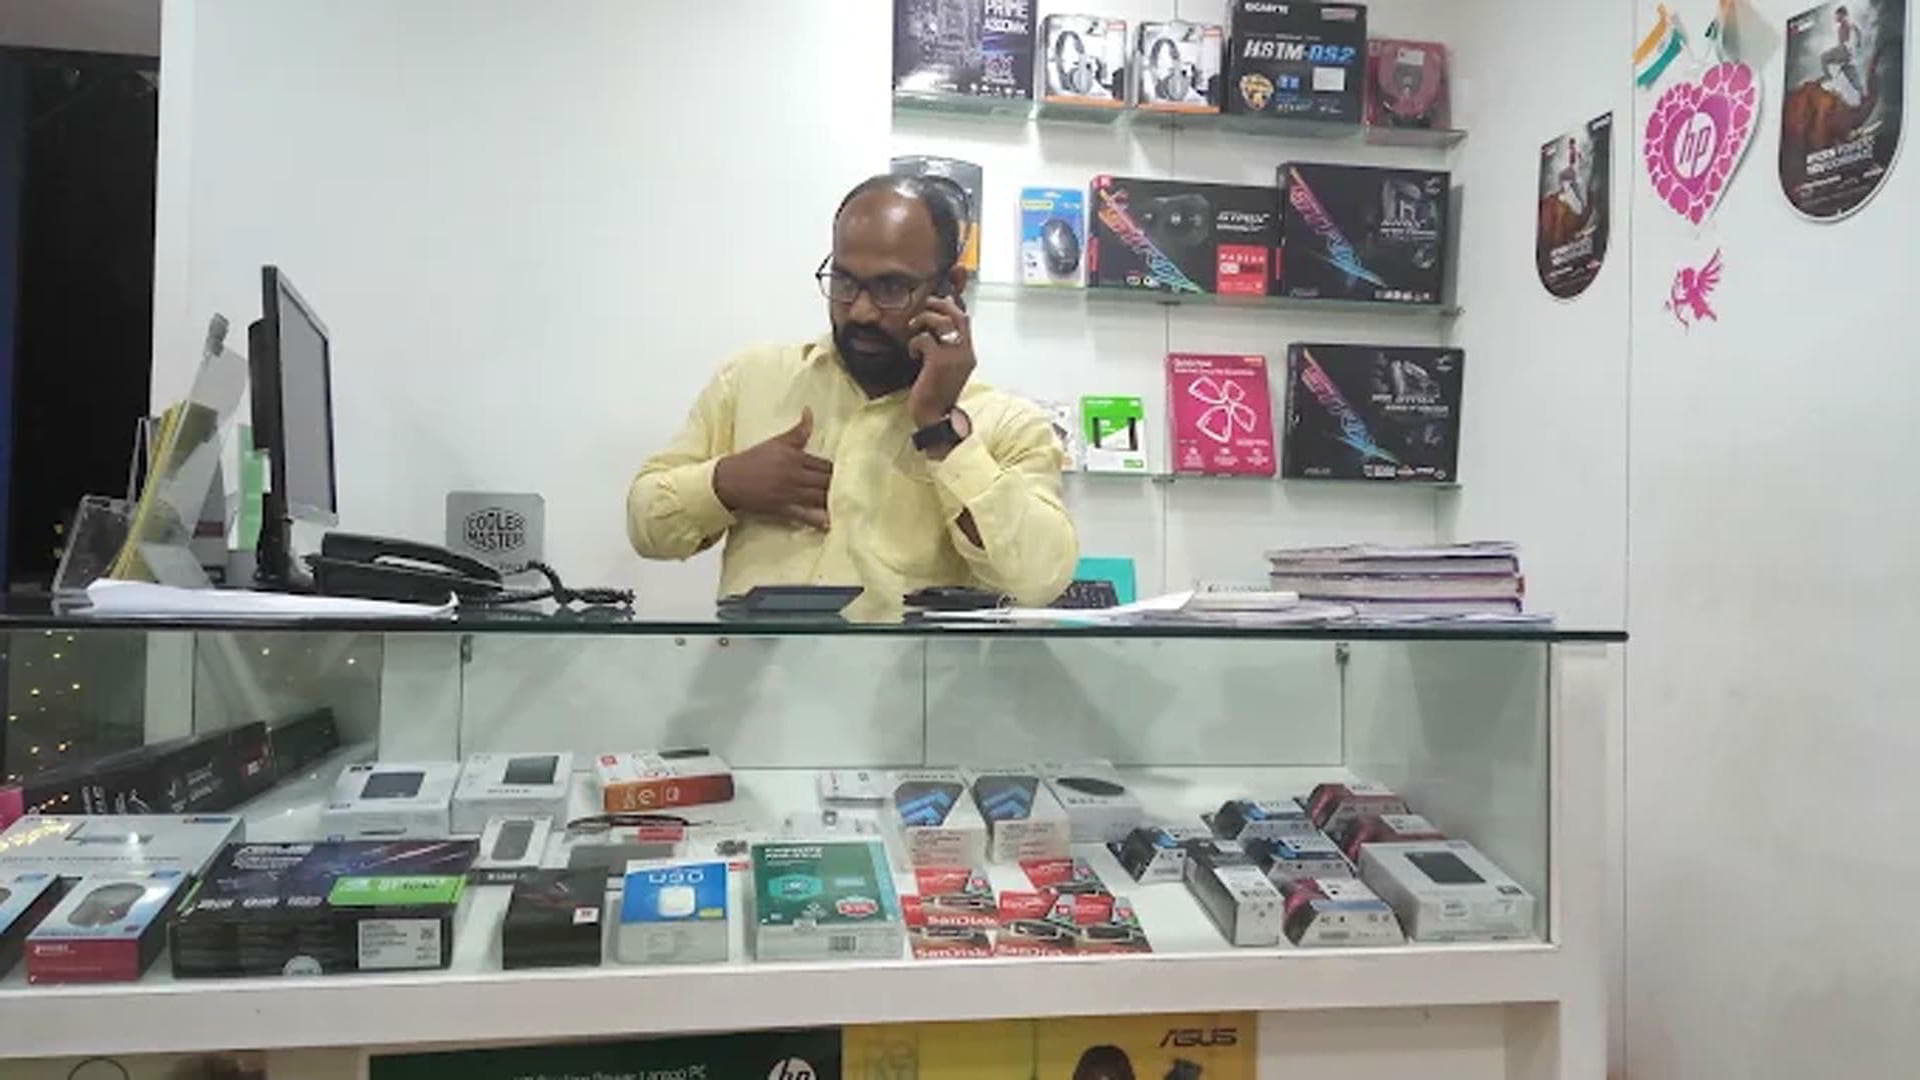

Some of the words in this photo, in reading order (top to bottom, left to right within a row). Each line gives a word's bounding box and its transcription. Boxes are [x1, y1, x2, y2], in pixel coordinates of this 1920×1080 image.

[1243, 39, 1355, 62] H81M-DS2
[1679, 119, 1711, 178] hp
[468, 511, 523, 531] COOLER
[468, 531, 523, 549] MASTER
[928, 914, 996, 926] SanDisk
[1159, 1028, 1237, 1048] ASUS
[688, 1065, 707, 1079] PC
